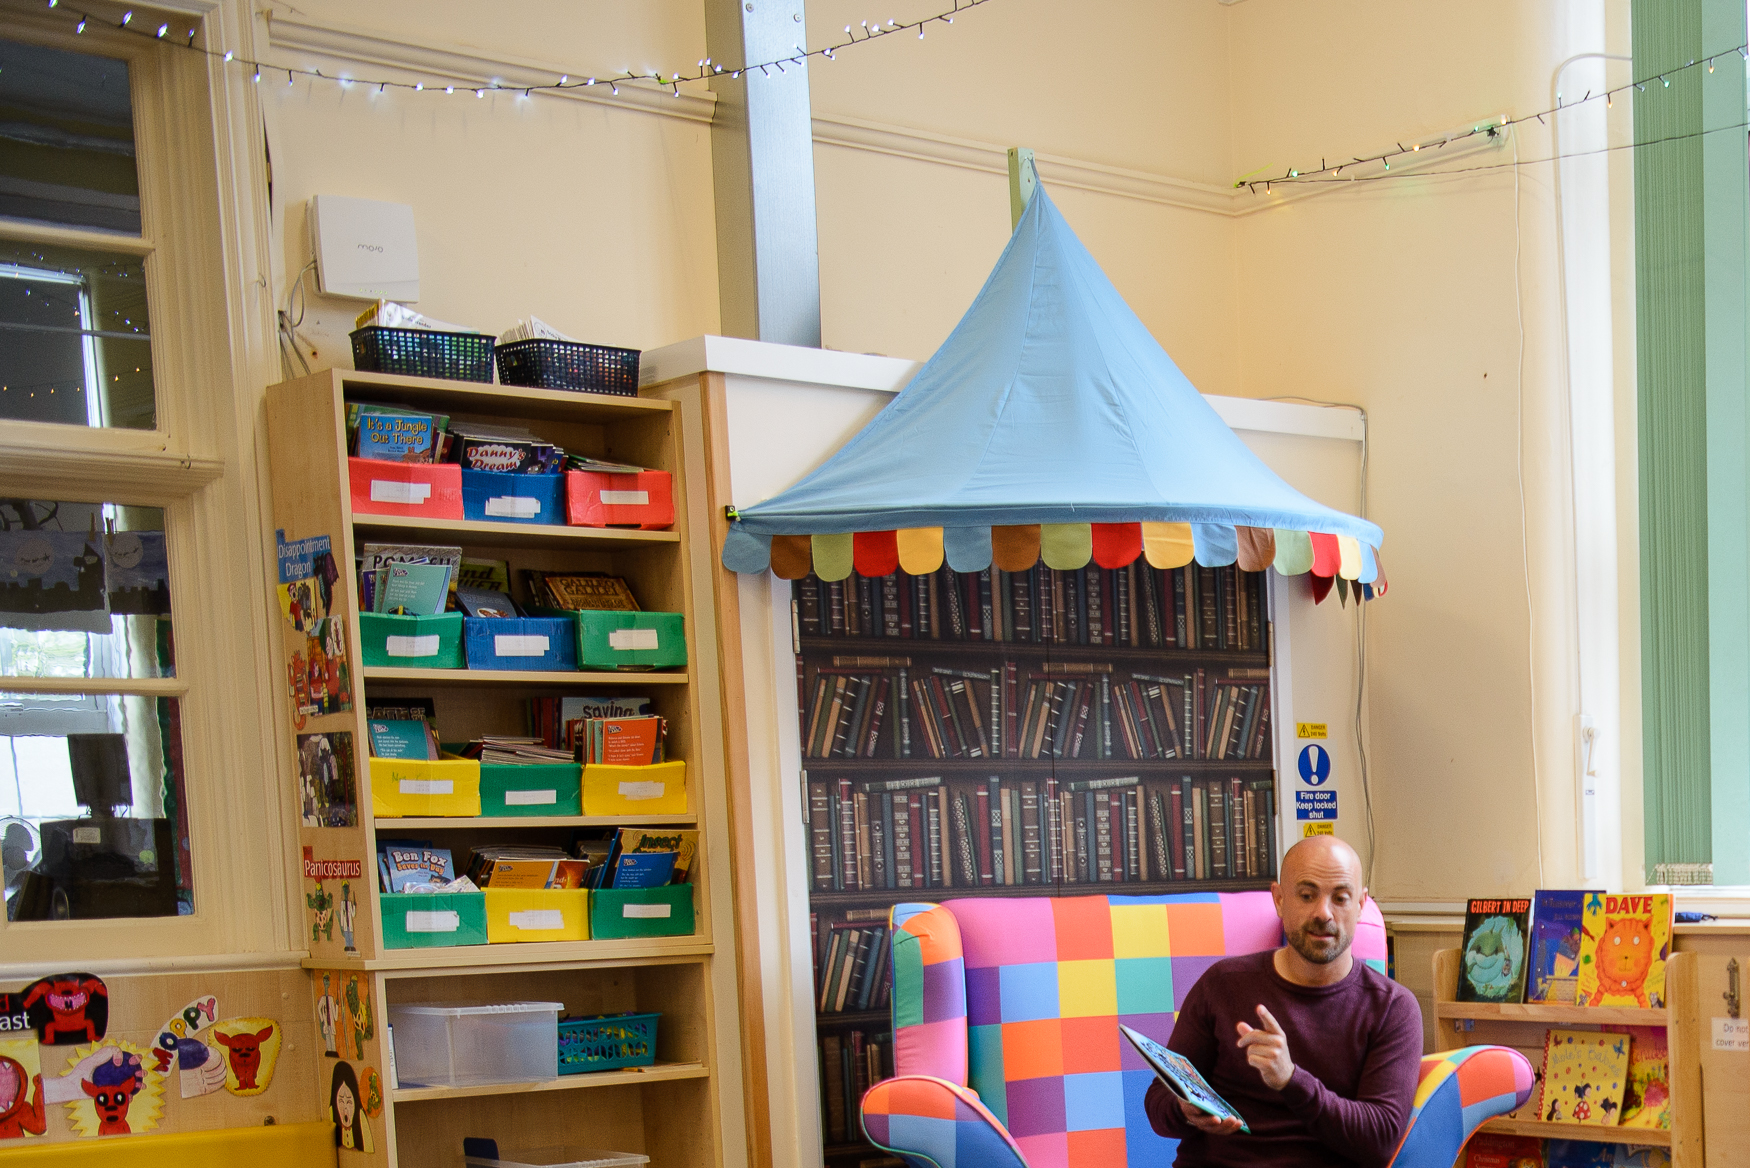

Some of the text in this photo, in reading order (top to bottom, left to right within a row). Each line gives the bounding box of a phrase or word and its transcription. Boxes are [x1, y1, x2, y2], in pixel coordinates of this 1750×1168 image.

[367, 417, 428, 435] It's a Jungle
[371, 432, 423, 445] Out There
[467, 446, 526, 461] Danny's
[471, 459, 518, 471] Dream
[278, 536, 331, 559] Disappointment
[285, 561, 311, 578] Dragon
[1300, 792, 1331, 800] Fire door
[1296, 801, 1336, 810] Keep locked
[1309, 811, 1324, 819] shut
[639, 834, 683, 849] Insect
[393, 851, 447, 866] Ben Fox
[304, 860, 360, 877] Panicosaurus
[396, 863, 419, 871] Saves
[429, 864, 445, 875] Day
[1471, 900, 1529, 914] GILBERT IN DEEP
[1605, 896, 1654, 914] DAVE
[0, 1011, 31, 1030] ast
[1723, 1023, 1734, 1032] Do
[1716, 1039, 1735, 1047] cover
